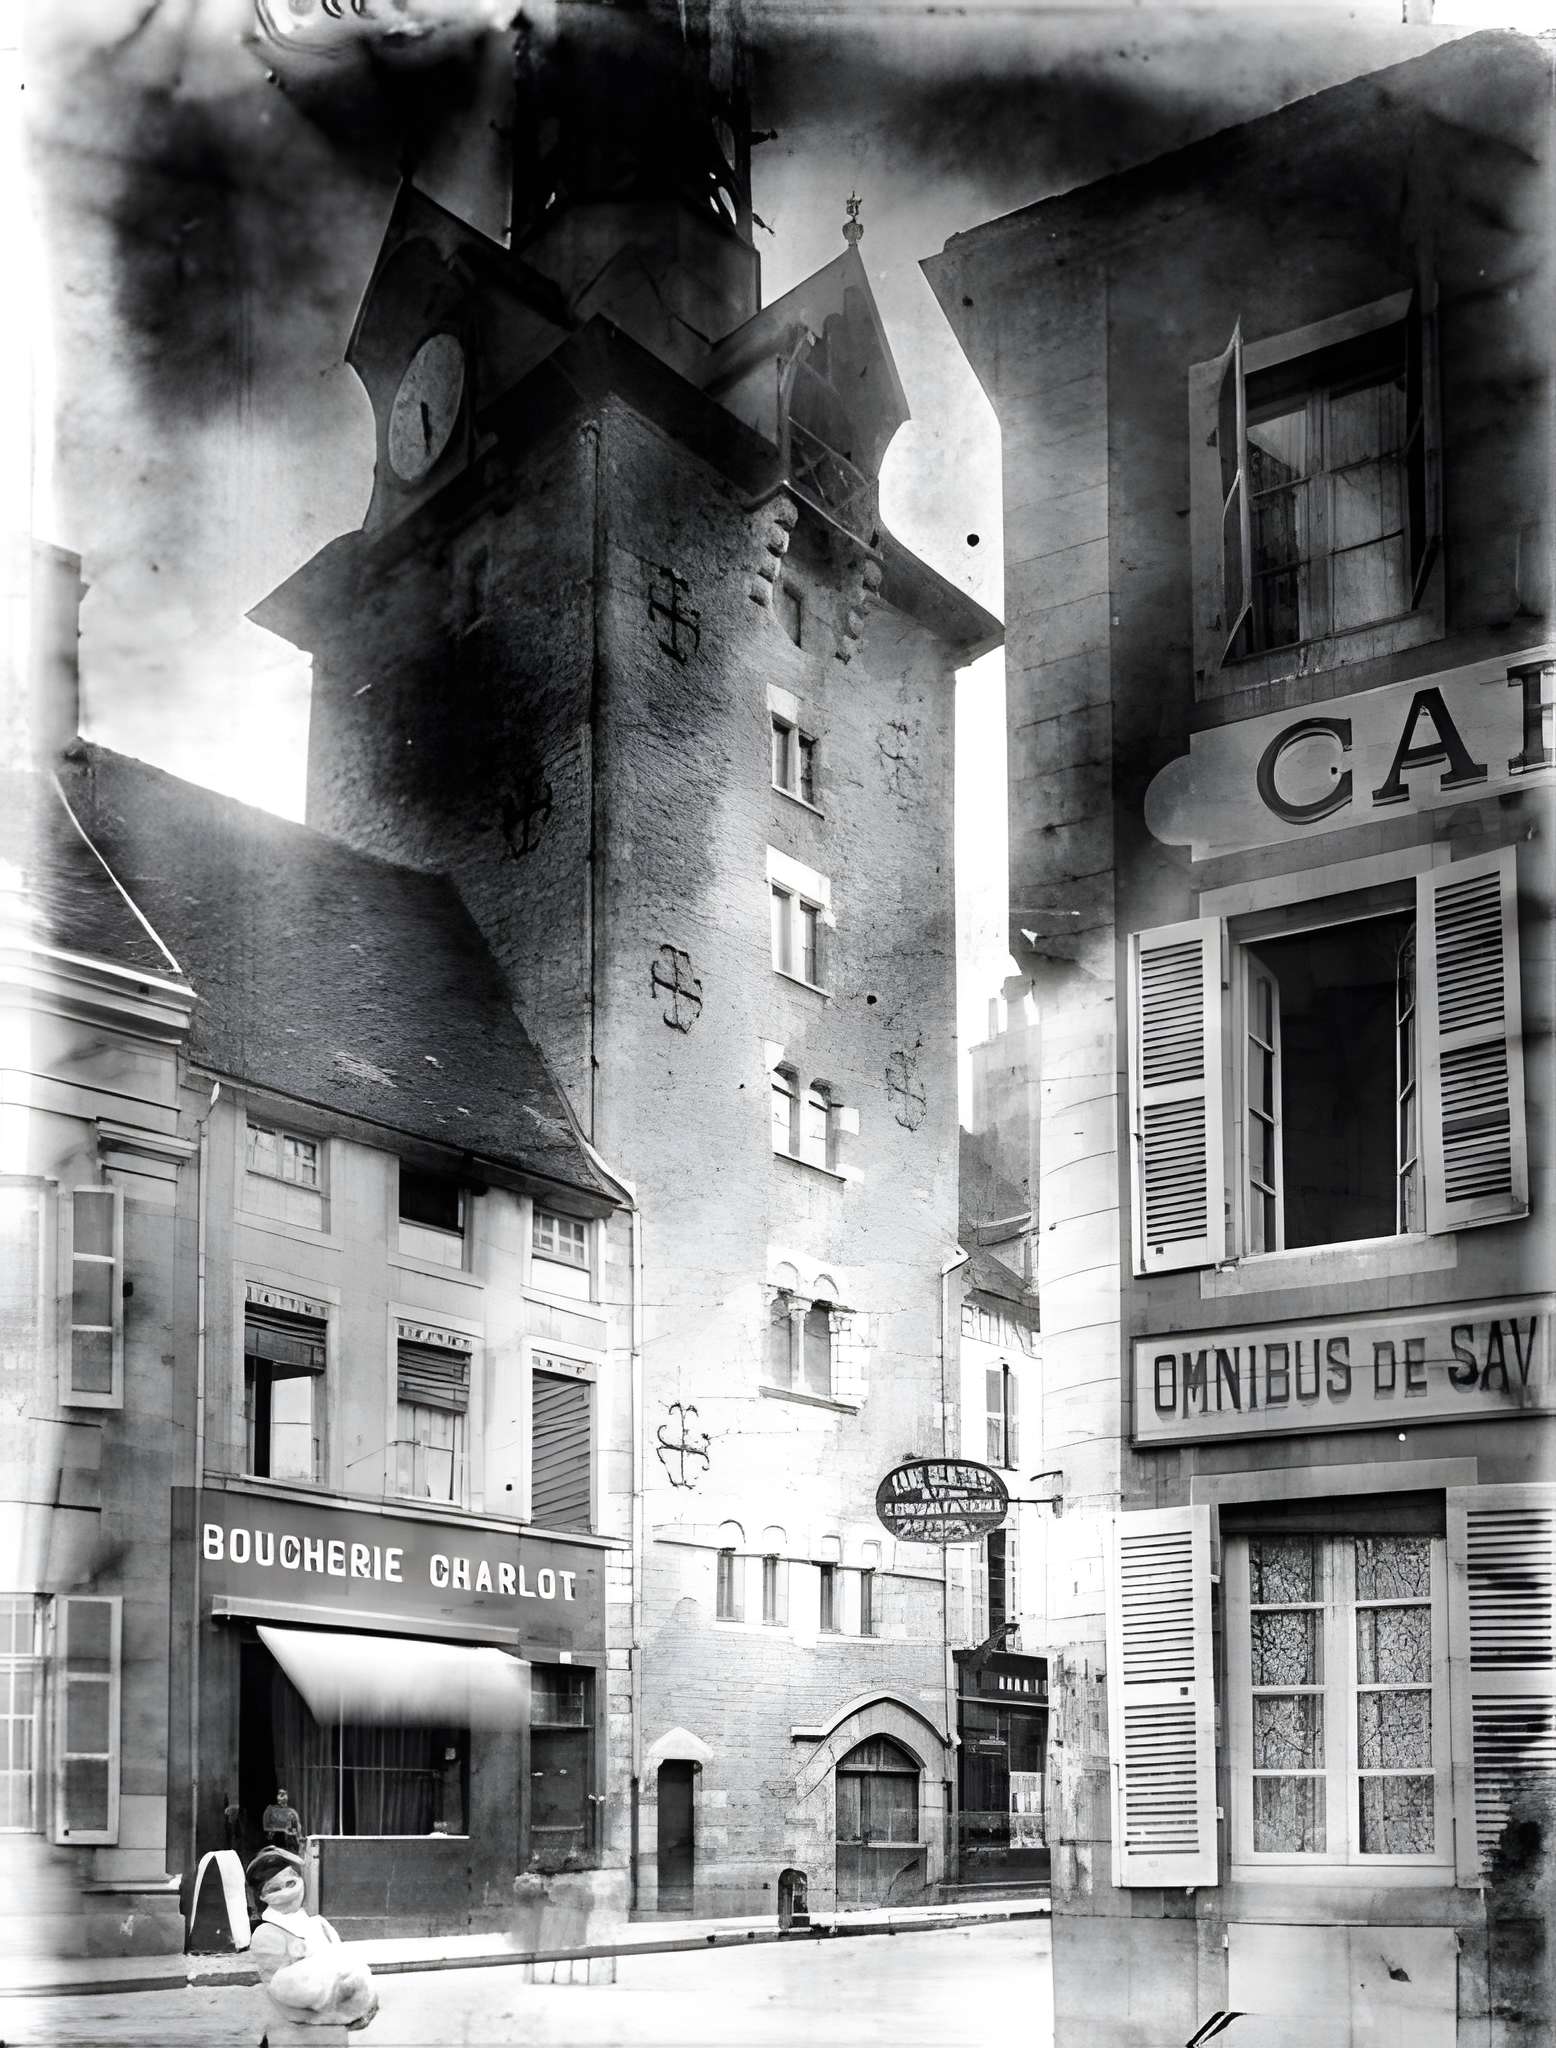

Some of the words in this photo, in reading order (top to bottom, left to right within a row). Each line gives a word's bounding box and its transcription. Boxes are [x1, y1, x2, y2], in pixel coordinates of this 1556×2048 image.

[1153, 1336, 1353, 1420] OMNIBUS
[1373, 1337, 1428, 1399] DE
[203, 1522, 404, 1584] BOUCHERIE
[430, 1553, 577, 1601] CHARLOT
